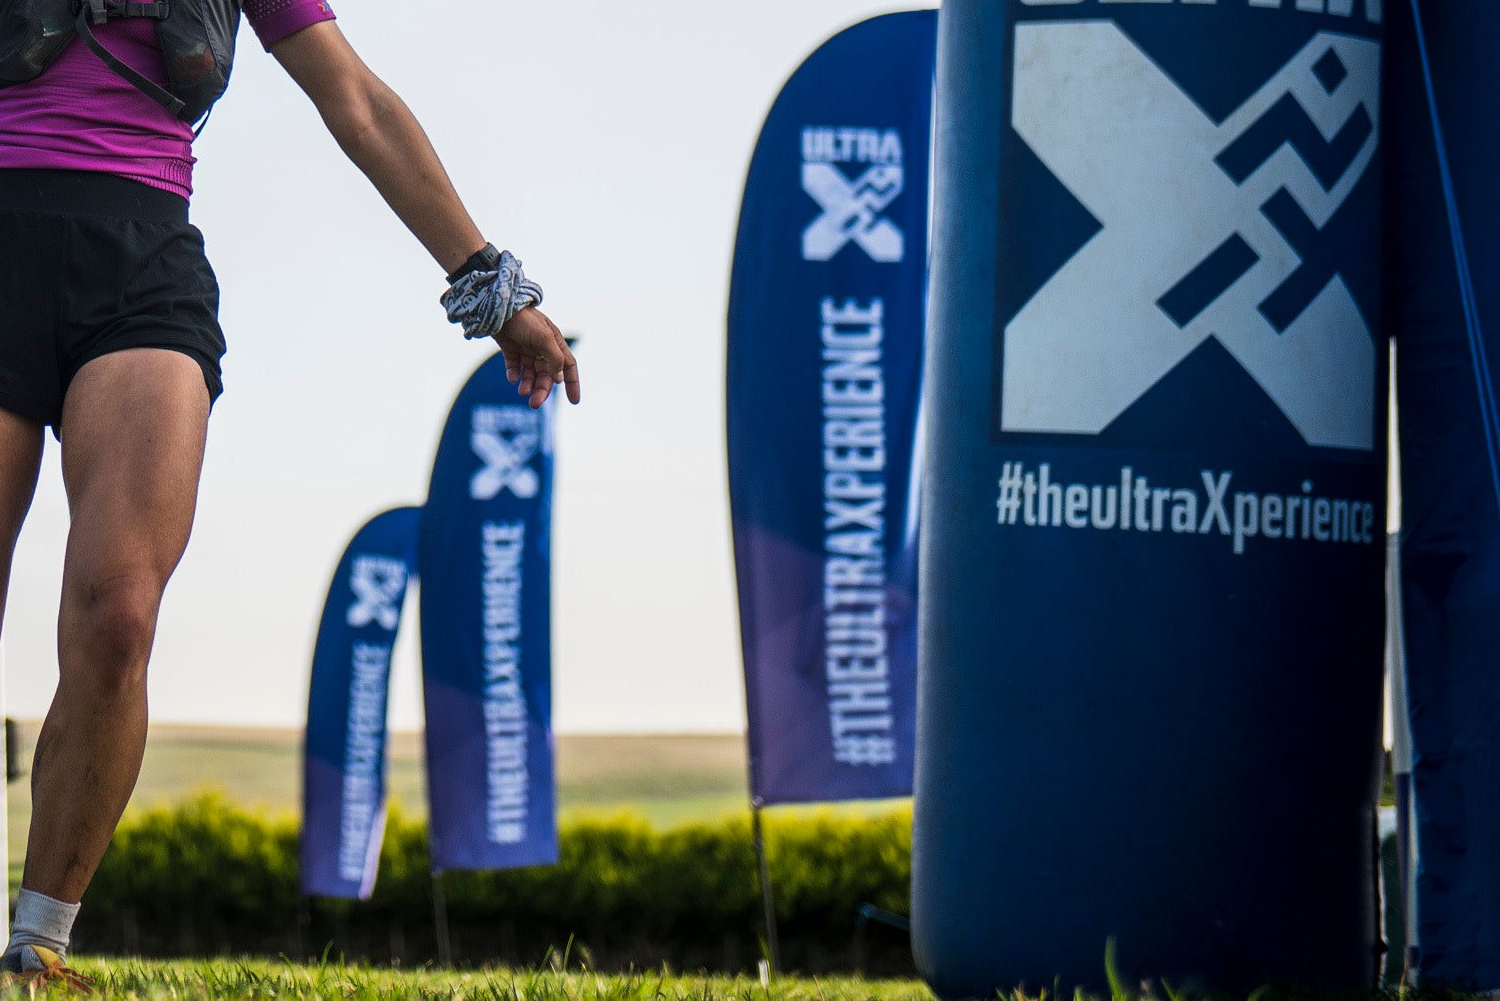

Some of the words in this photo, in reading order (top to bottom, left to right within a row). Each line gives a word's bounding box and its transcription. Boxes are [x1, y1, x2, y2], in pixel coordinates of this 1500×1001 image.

[801, 127, 903, 164] ULTRA
[821, 297, 896, 766] #THEULTRAXPERIENCE
[997, 461, 1374, 556] #theultraXperience
